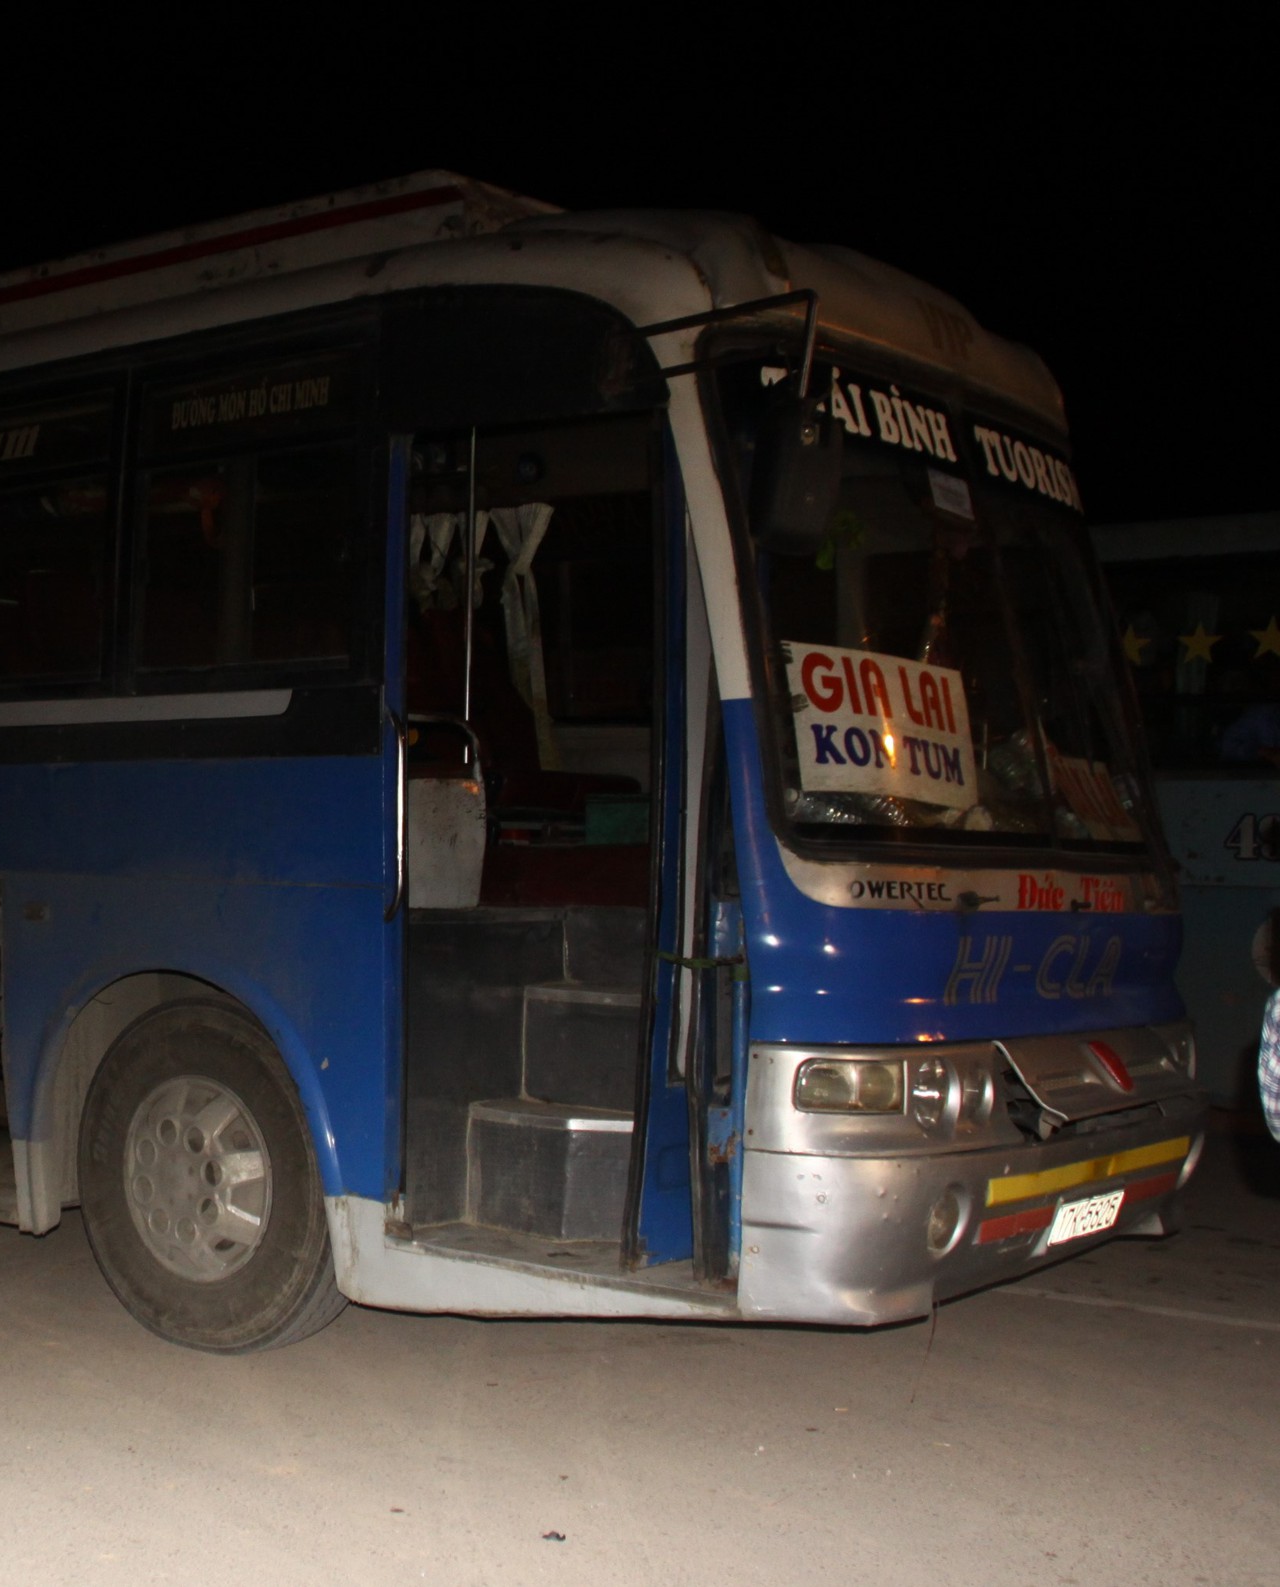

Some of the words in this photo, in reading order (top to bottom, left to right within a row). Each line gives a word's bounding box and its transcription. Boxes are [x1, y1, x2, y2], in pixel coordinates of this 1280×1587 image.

[801, 652, 892, 718] GIA
[898, 665, 957, 734] LAI
[903, 736, 965, 786] TUM
